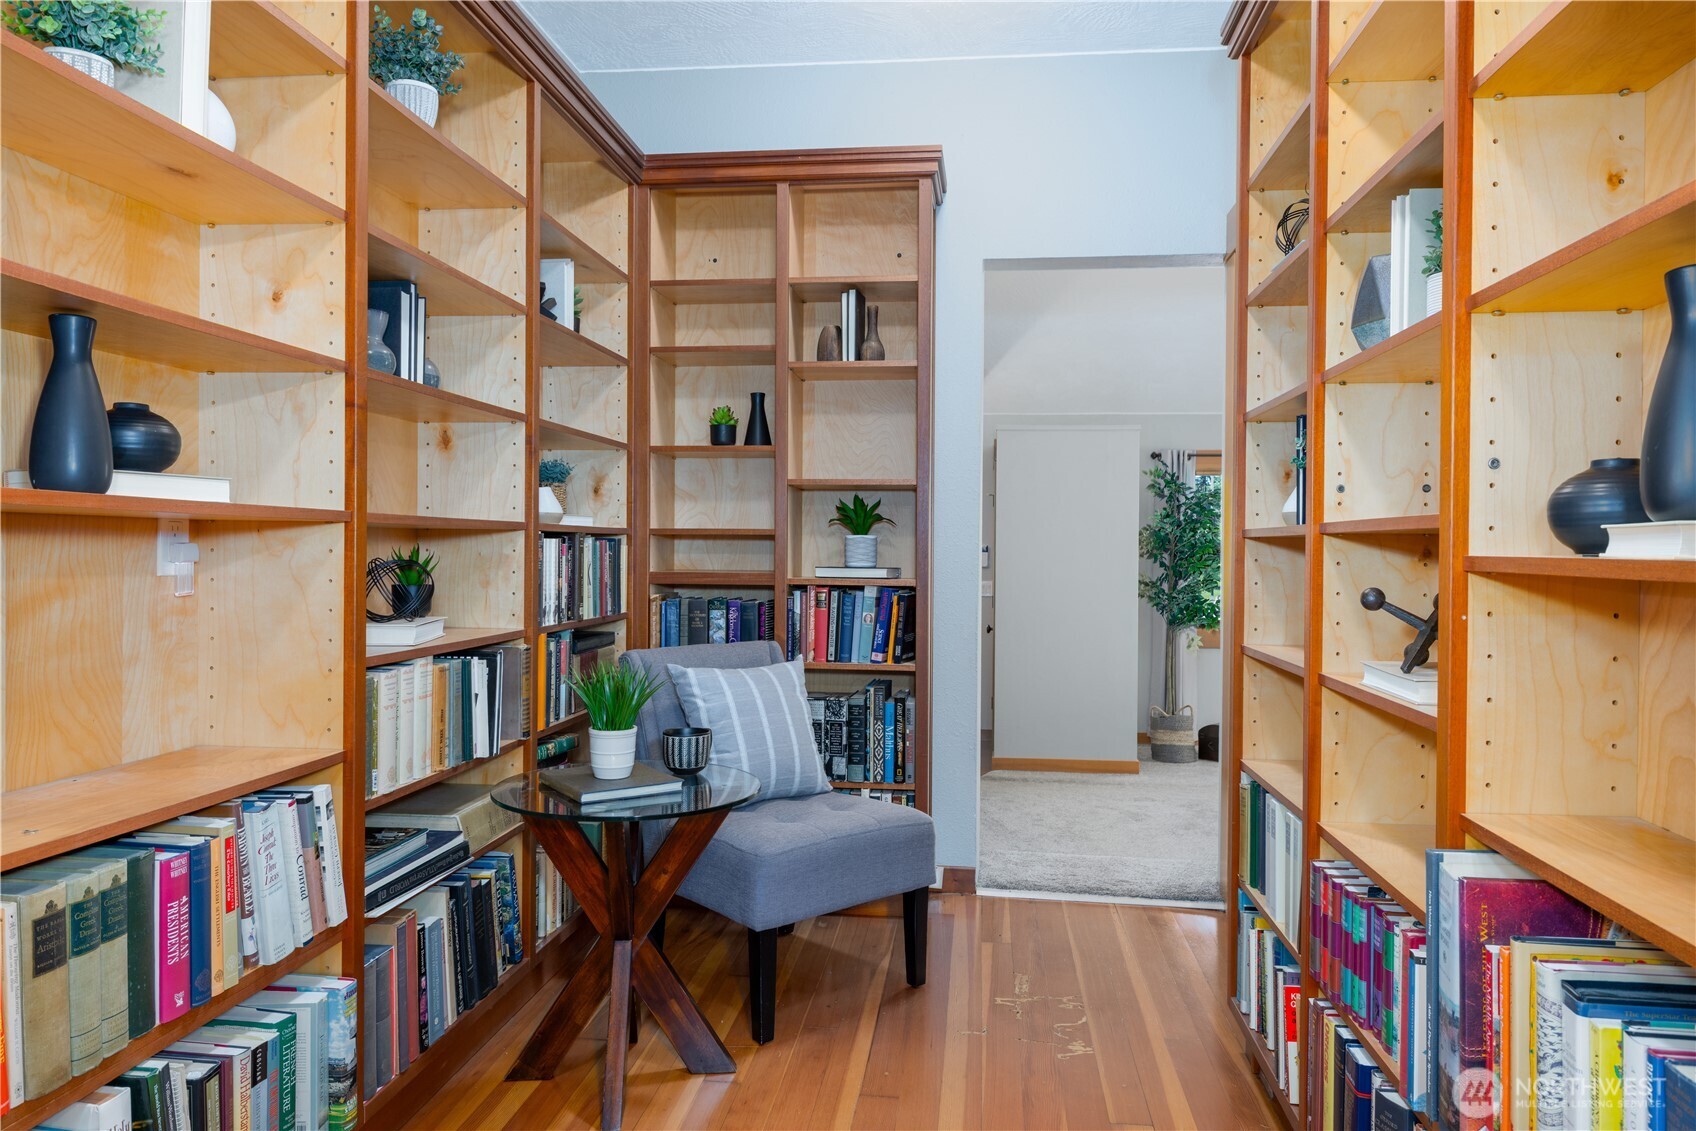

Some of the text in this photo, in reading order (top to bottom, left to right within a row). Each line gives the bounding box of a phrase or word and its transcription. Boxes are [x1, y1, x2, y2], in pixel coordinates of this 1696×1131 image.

[884, 726, 894, 760] Malthus
[170, 866, 188, 879] WHITNEY
[238, 828, 254, 914] DARWIN BEAGLE
[264, 862, 278, 876] Three
[296, 854, 308, 901] Conrad
[167, 900, 180, 966] PRESIDENTS
[180, 895, 190, 960] AMERICAN
[1480, 903, 1488, 942] WEST
[240, 1056, 250, 1086] David
[282, 1043, 291, 1114] LITERATURE
